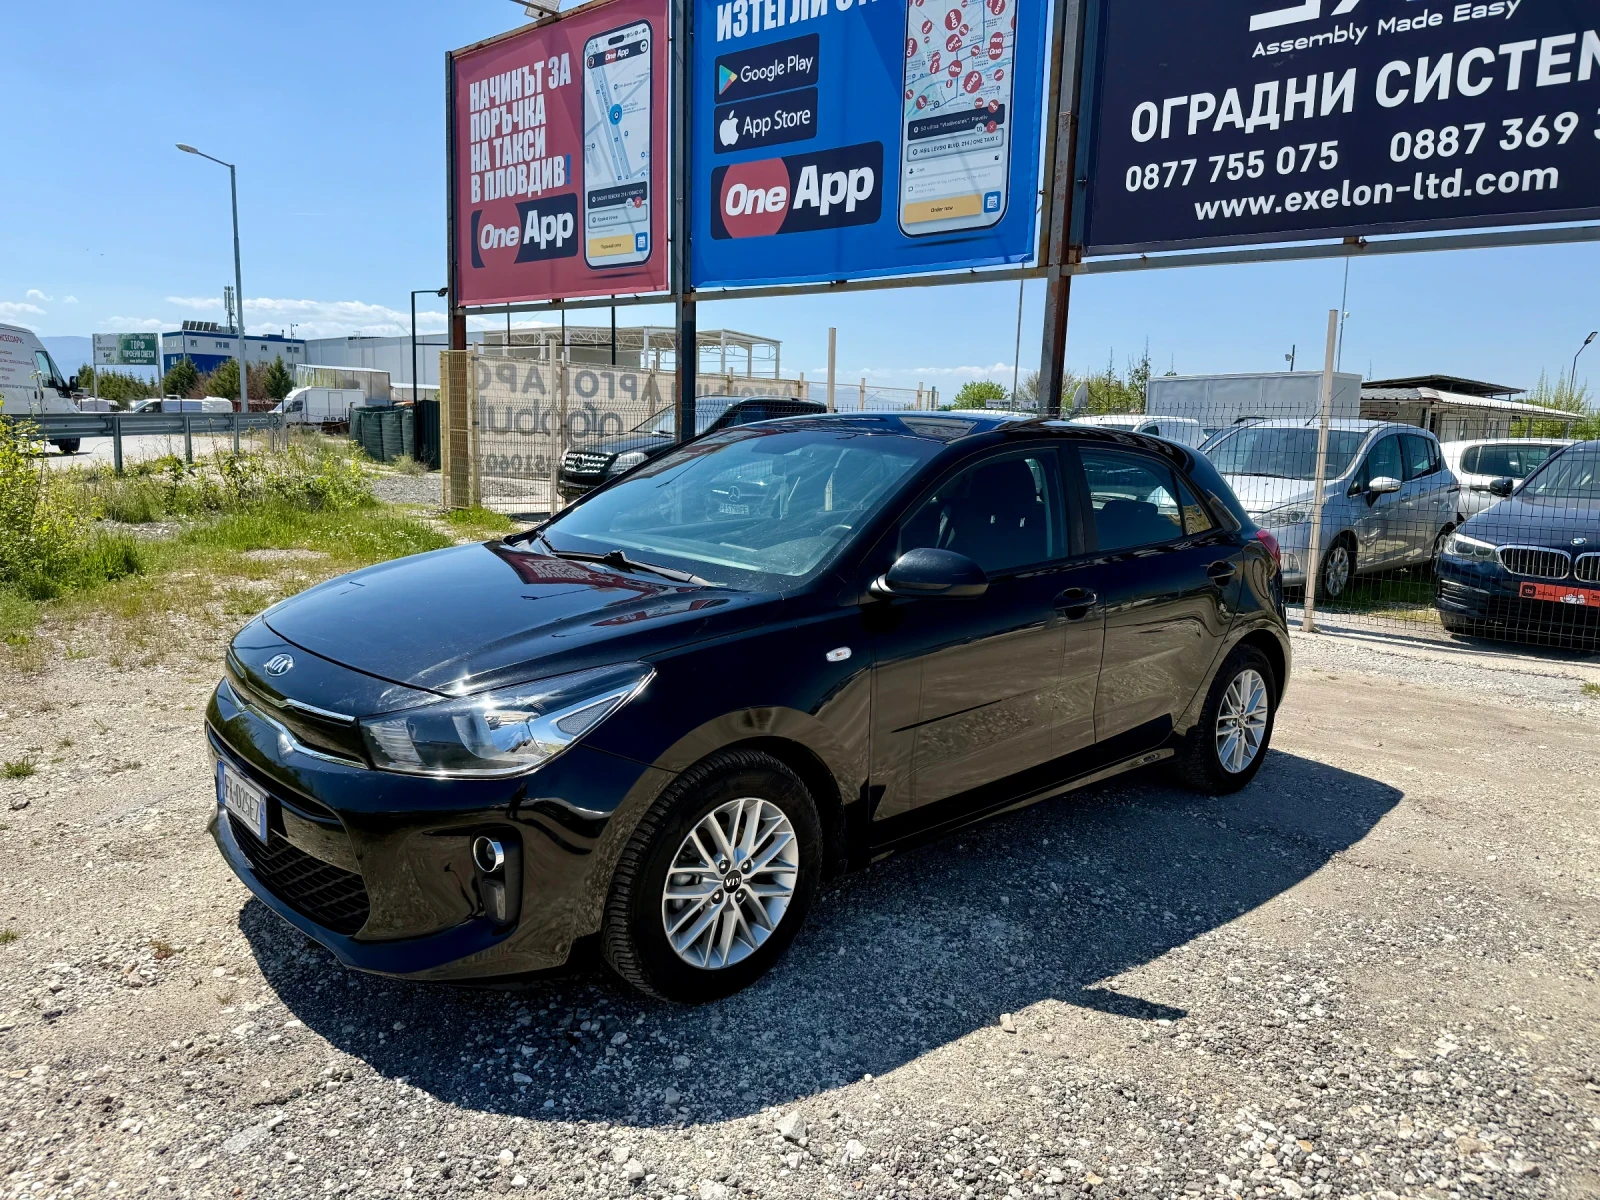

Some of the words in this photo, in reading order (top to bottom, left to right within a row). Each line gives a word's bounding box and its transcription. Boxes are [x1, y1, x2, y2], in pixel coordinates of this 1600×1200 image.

[605, 53, 617, 61] One
[617, 48, 630, 58] App
[1252, 23, 1368, 58] Assembly
[1377, 10, 1443, 36] Made
[1453, 0, 1521, 22] Easy
[469, 60, 545, 112] НАЧИНЪТ
[548, 53, 571, 90] ЗА
[740, 59, 785, 83] Google
[787, 54, 814, 74] Play
[470, 94, 547, 143] ПОРЪЧКА
[743, 116, 771, 138] App
[774, 109, 811, 130] Store
[1131, 68, 1356, 143] ОГРАДНИ
[471, 142, 491, 173] НА
[493, 126, 546, 169] ТАКСИ
[1390, 122, 1486, 163] 0887
[1499, 111, 1579, 151] 369
[471, 174, 480, 204] В
[484, 153, 571, 202] ПЛОВДИВ!
[725, 183, 787, 217] One
[793, 165, 875, 216] App
[1125, 159, 1197, 192] 0877
[1208, 150, 1265, 184] 755
[1276, 140, 1339, 175] 075
[1194, 167, 1559, 221] www.exelon-ltd.com
[480, 223, 519, 250] One
[523, 209, 574, 250] App
